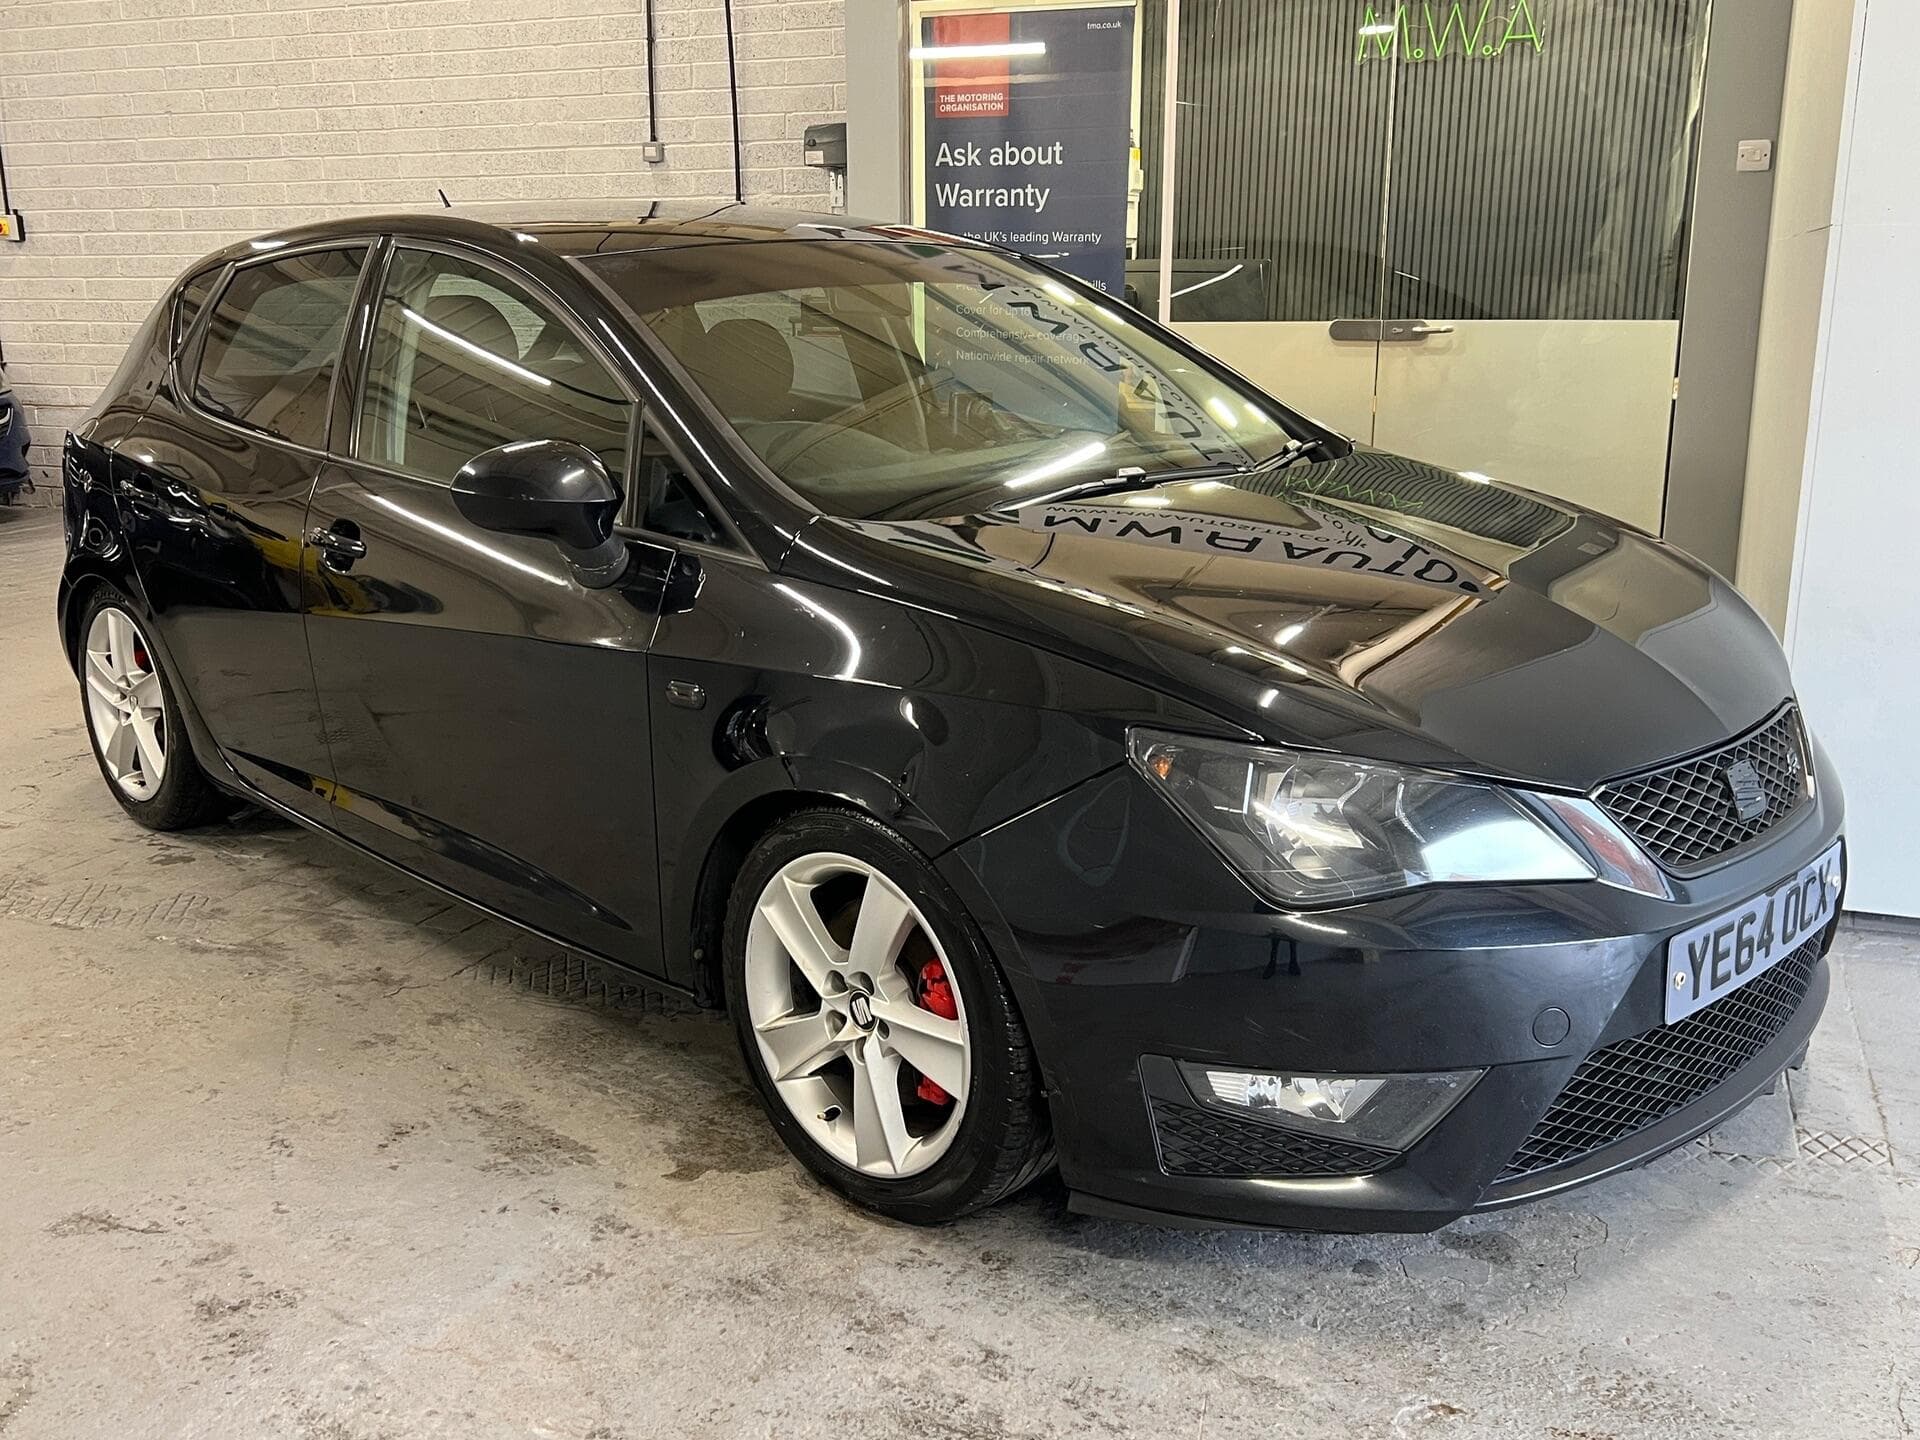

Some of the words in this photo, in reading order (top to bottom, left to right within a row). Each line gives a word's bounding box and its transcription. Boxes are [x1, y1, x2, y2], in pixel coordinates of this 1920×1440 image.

[1087, 20, 1122, 30] tmo.co.uk
[1357, 0, 1543, 62] M.W.A
[939, 94, 956, 103] THE
[957, 92, 1004, 102] MOTORING
[940, 102, 1004, 112] ORGANISATION
[935, 142, 982, 167] Ask
[989, 141, 1063, 166] about
[935, 183, 1050, 213] Warranty
[984, 232, 1008, 243] UK's
[1010, 232, 1049, 244] leading
[1052, 231, 1102, 245] Warranty
[956, 304, 987, 316] Cover
[989, 305, 1003, 316] for
[1004, 307, 1019, 319] up
[956, 326, 1035, 342] Comprehensive
[956, 350, 1013, 362] Nationwide
[1014, 353, 1044, 365] repair
[1688, 897, 1775, 1001] YE64
[1782, 859, 1832, 946] OCX
